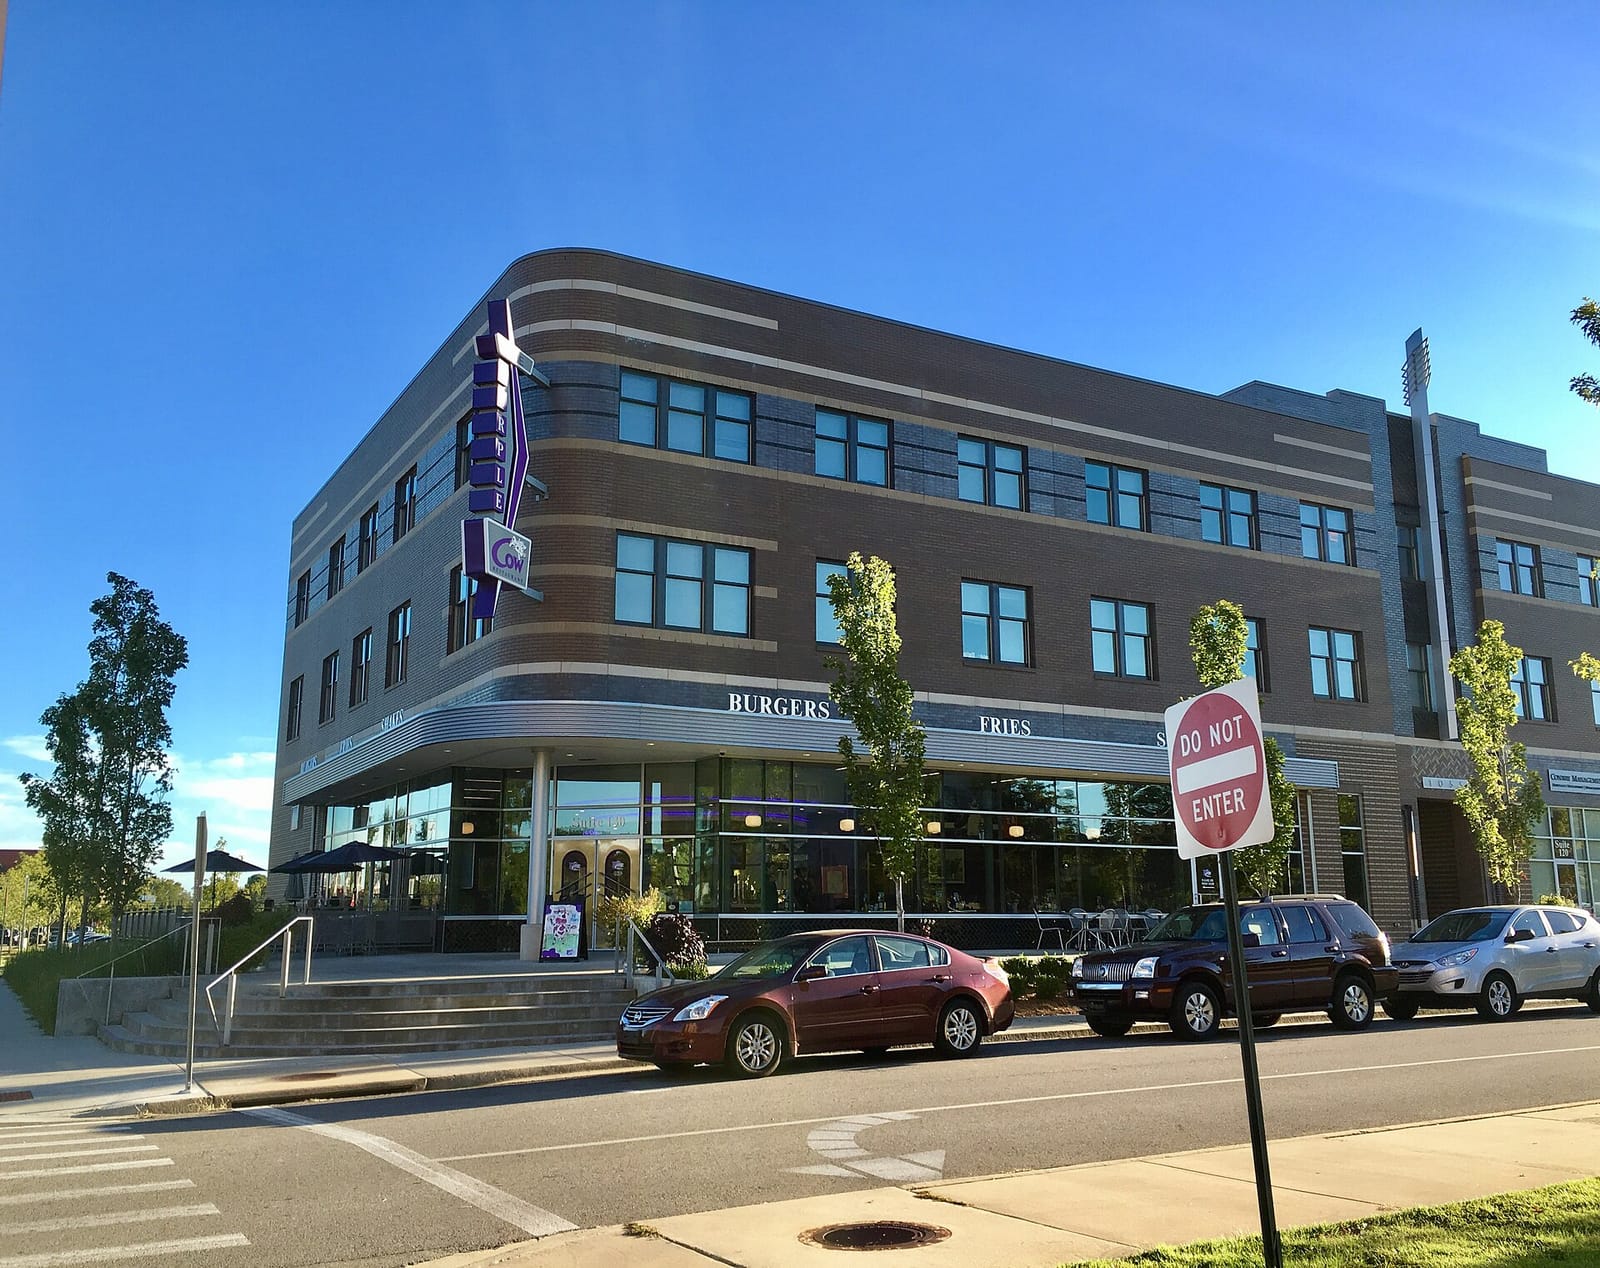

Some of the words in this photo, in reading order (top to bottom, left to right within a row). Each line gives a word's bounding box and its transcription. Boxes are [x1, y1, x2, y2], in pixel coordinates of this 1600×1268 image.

[728, 692, 830, 720] BURGERS
[979, 715, 1031, 736] FRIES
[1180, 729, 1202, 757] DO
[1209, 714, 1243, 748] NOT
[1192, 787, 1246, 823] ENTER
[1554, 839, 1570, 849] Suite
